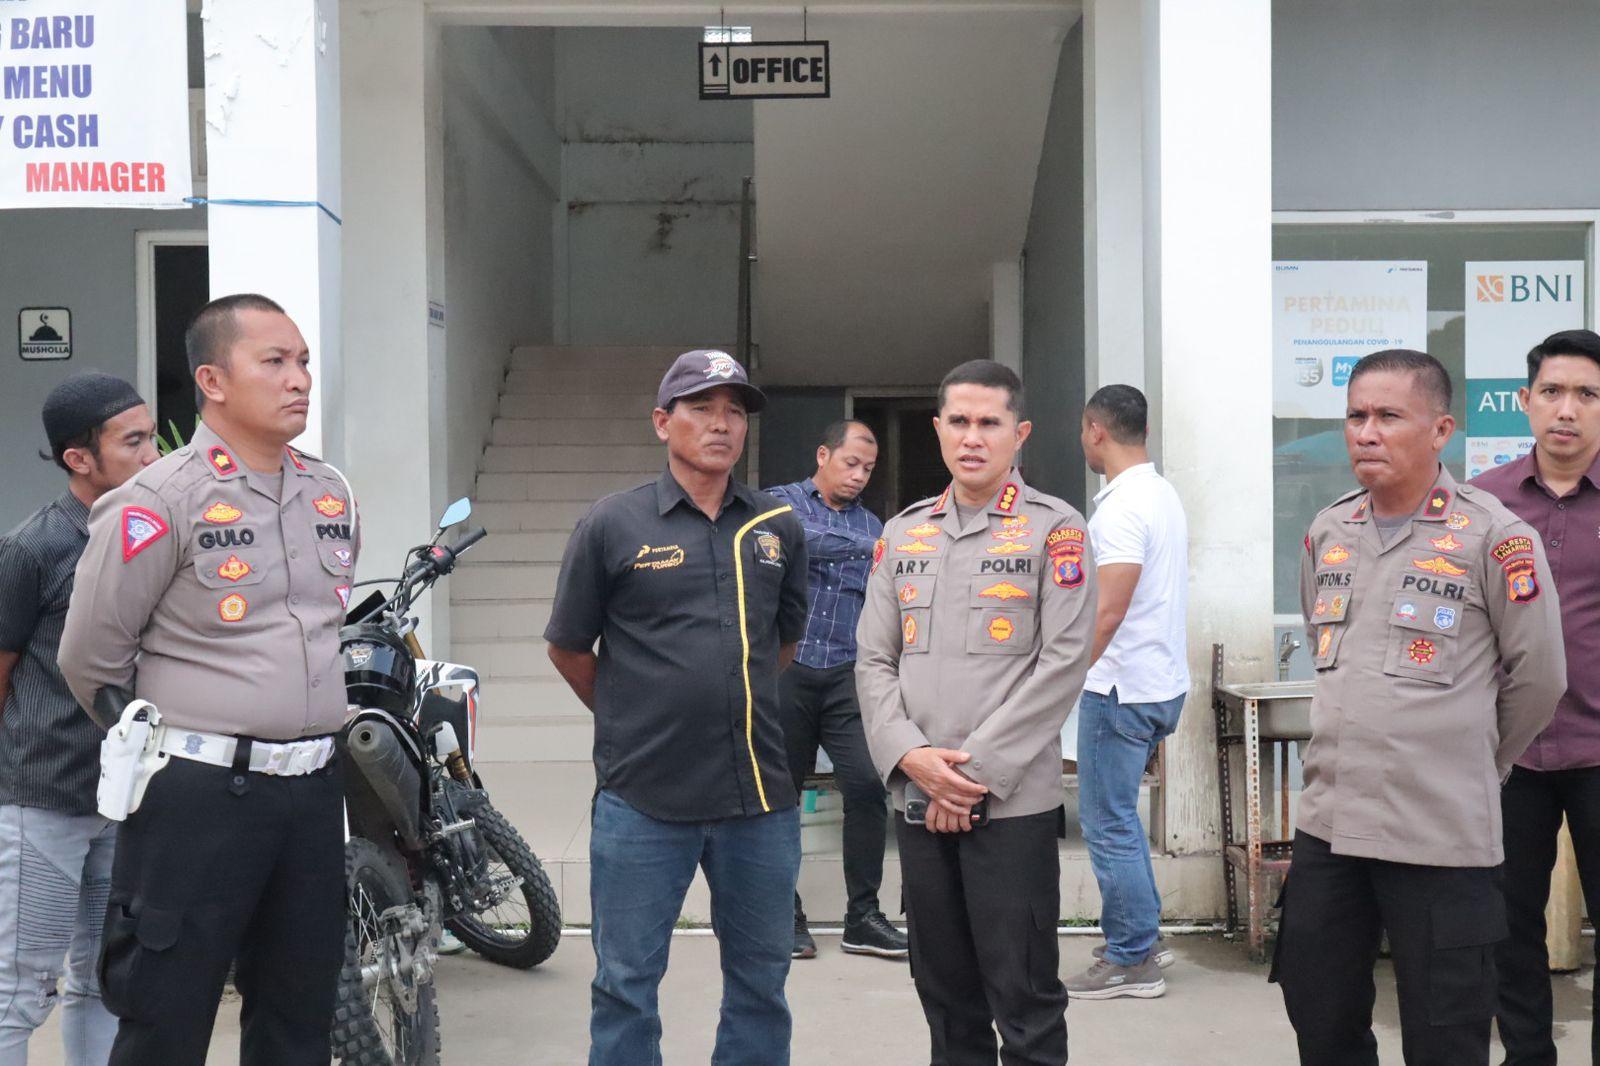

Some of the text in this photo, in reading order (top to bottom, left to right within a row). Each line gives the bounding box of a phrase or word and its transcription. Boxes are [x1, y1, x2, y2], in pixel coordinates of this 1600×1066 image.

[10, 15, 95, 49] BARU
[3, 64, 92, 99] MENU
[733, 57, 823, 84] OFFICE
[13, 114, 99, 149] CASH
[26, 161, 166, 193] MANAGER
[1510, 274, 1573, 303] BNI
[1284, 296, 1410, 313] PERTAMINA
[1311, 317, 1385, 334] PEDULI
[22, 346, 69, 354] MUSHOLLA
[1478, 391, 1524, 413] ATM
[199, 528, 255, 549] GULO
[1493, 537, 1532, 555] POLRESTA
[895, 560, 930, 575] ARY
[980, 558, 1032, 573] POLRI
[1402, 574, 1465, 600] POLRI
